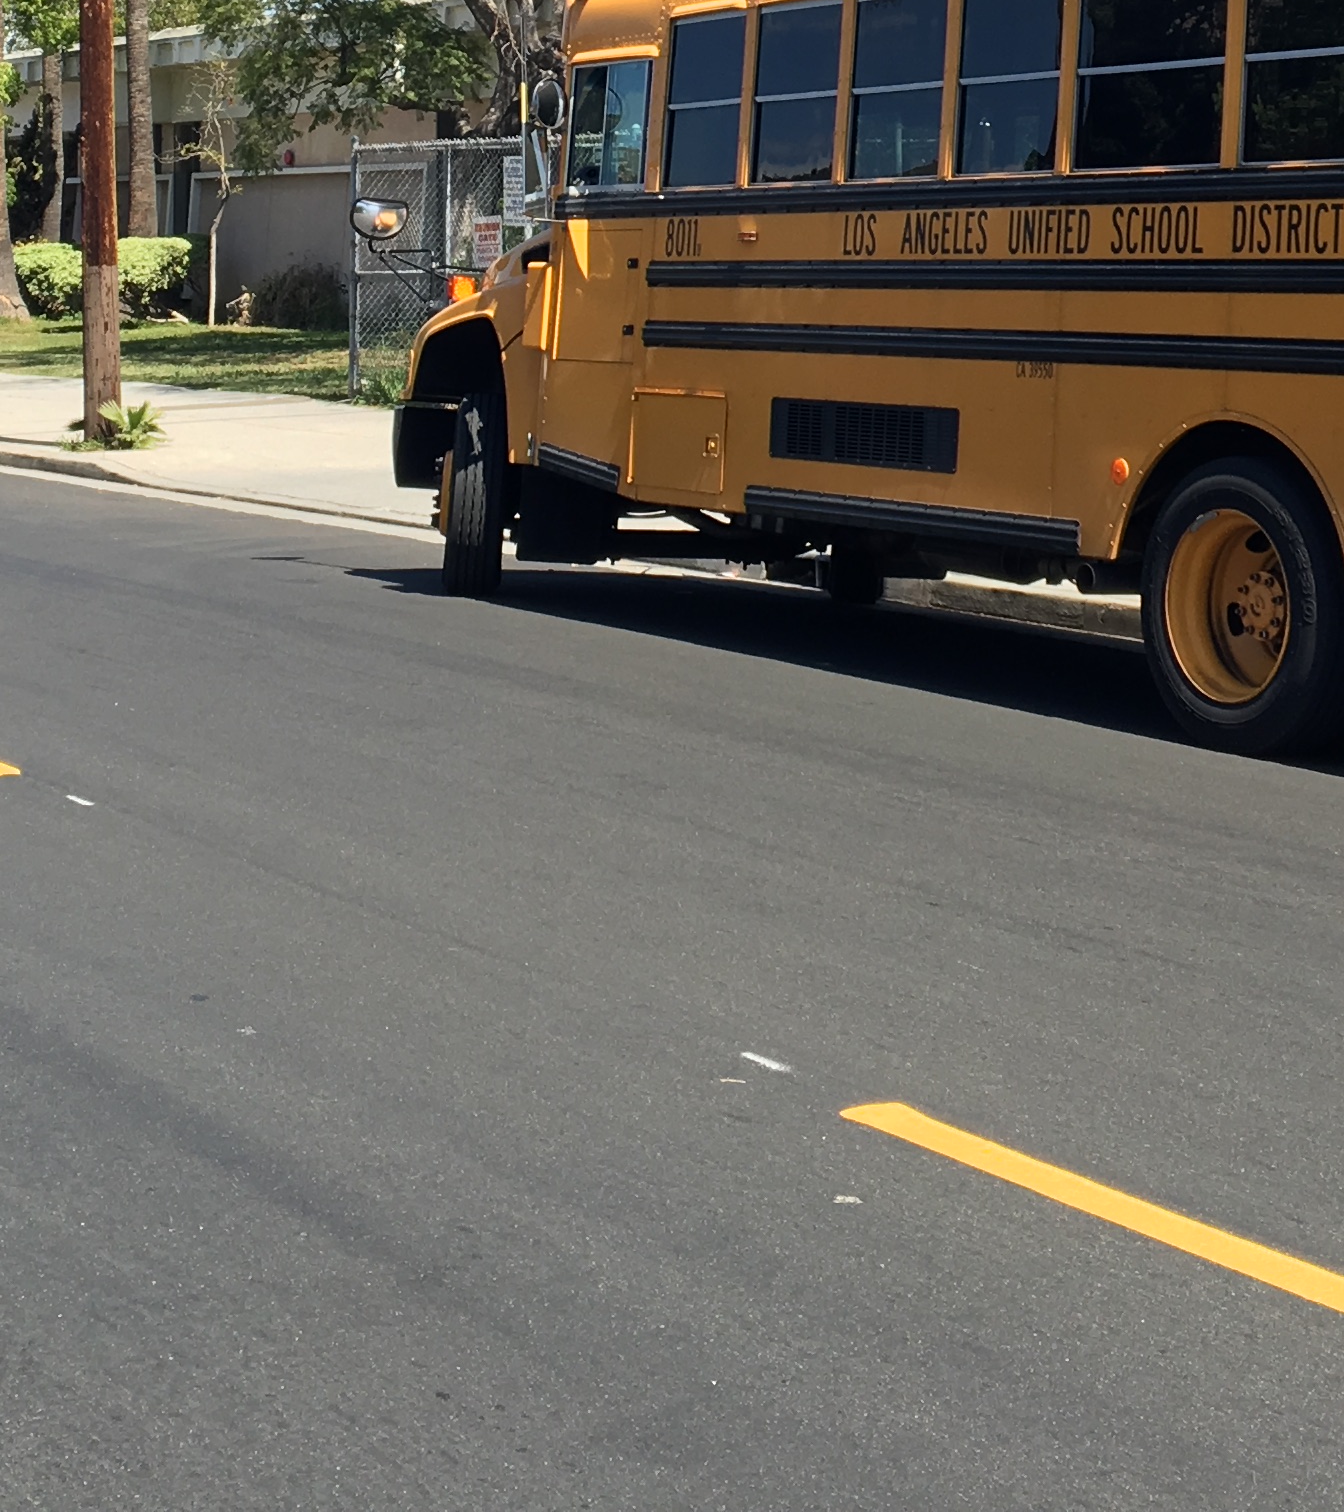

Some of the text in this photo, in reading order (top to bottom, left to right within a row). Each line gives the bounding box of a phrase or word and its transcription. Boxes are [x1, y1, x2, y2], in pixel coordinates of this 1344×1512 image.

[665, 218, 698, 257] 8011
[843, 203, 1344, 256] LOS ANGELES UNIFIED SCHOOL DISTRICT
